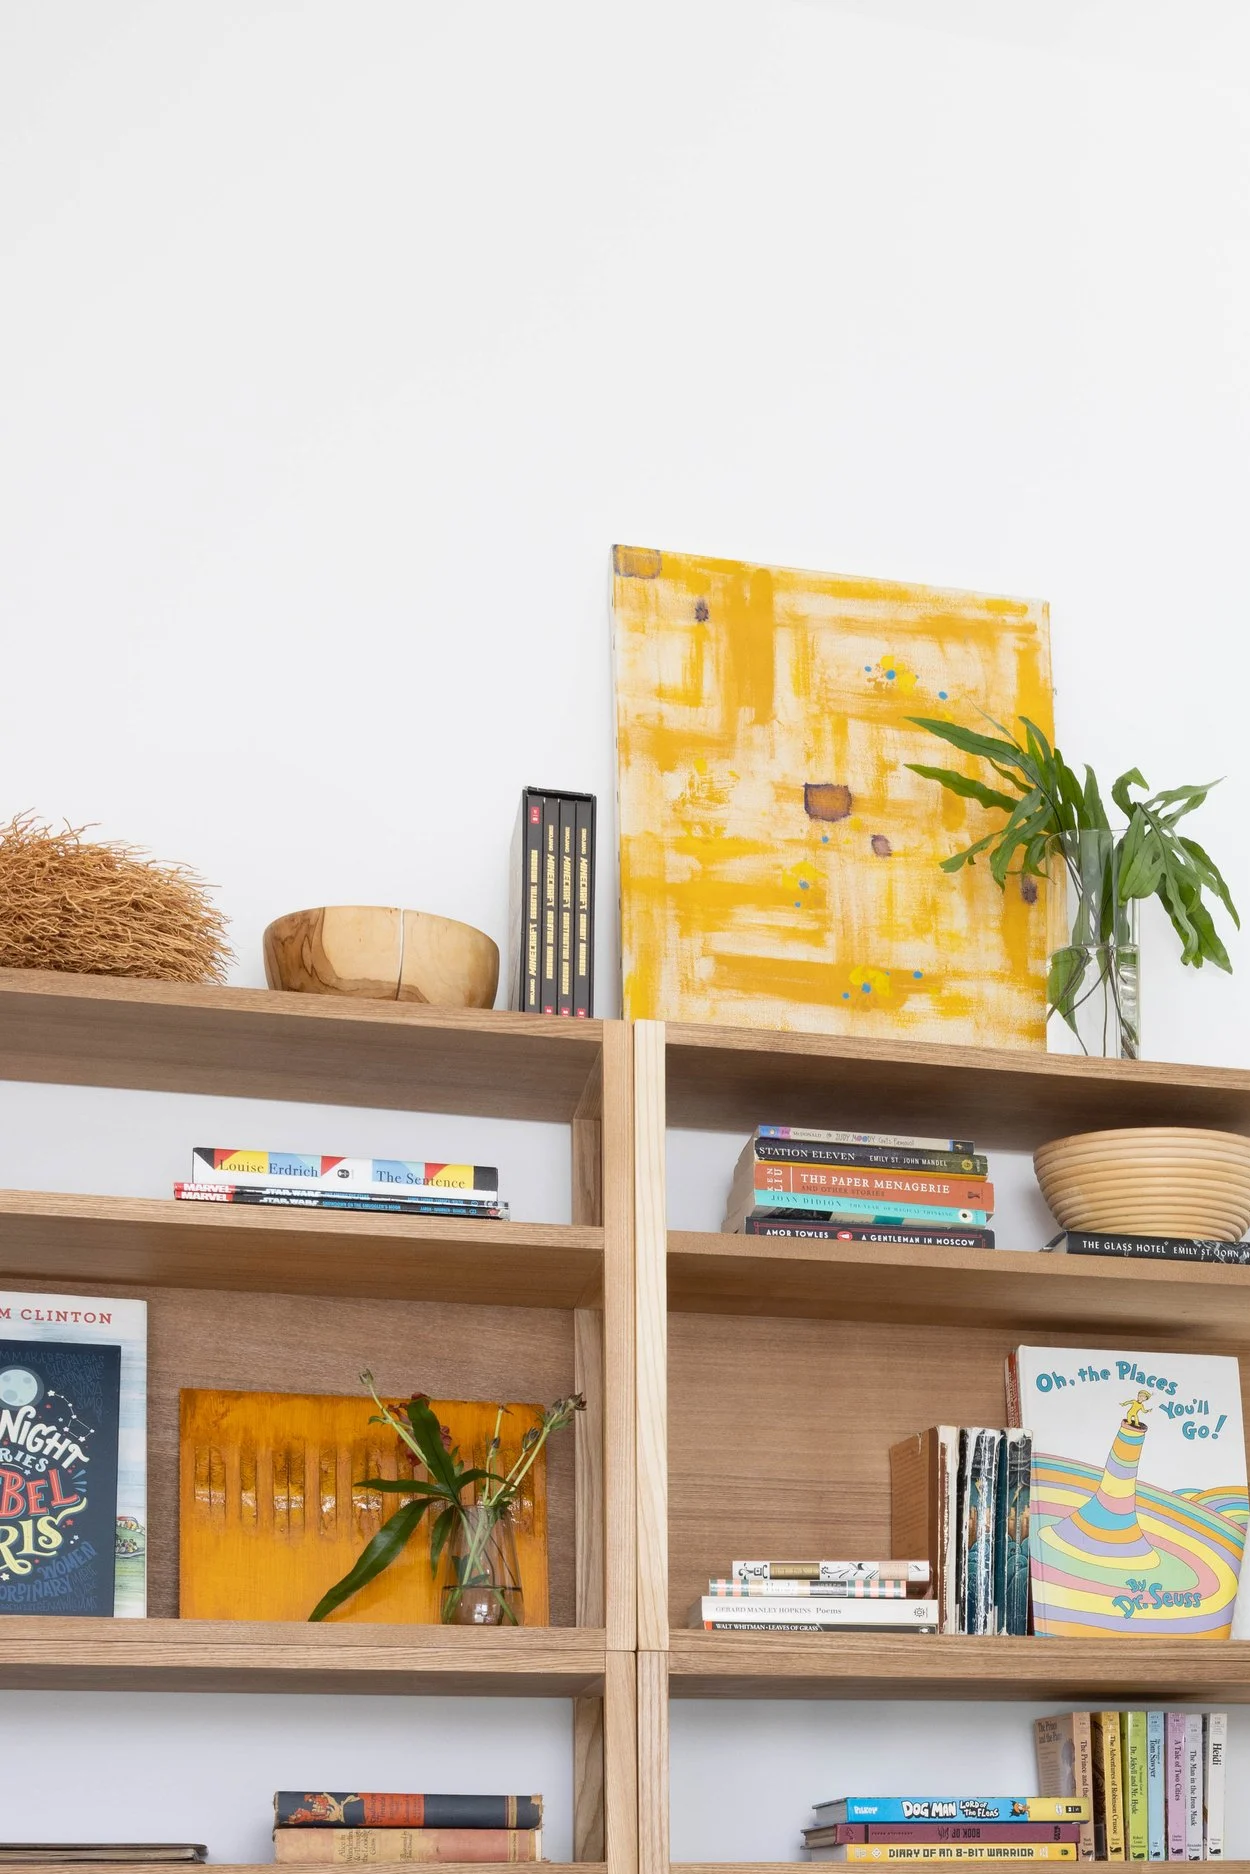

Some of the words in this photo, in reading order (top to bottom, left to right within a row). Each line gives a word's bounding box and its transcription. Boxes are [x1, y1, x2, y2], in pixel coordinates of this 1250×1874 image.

[547, 854, 555, 907] MINECRAFT
[563, 855, 571, 908] MINECRAFT
[760, 1147, 808, 1158] STATION
[812, 1150, 855, 1160] ELEVEN
[903, 1157, 920, 1165] JOHN
[921, 1159, 947, 1167] MANDEL
[219, 1159, 264, 1174] Louise
[269, 1163, 318, 1177] Erdrich
[377, 1170, 401, 1184] The
[406, 1173, 465, 1189] Sentence
[800, 1174, 827, 1184] THE
[831, 1176, 870, 1188] PAPER
[874, 1180, 950, 1194] MENAGERIE
[181, 1191, 229, 1201] MARVEL
[184, 1183, 232, 1193] MARVEL
[766, 1229, 791, 1237] AMOR
[795, 1230, 829, 1239] TOWLES
[870, 1234, 920, 1243] GENTLEMAN
[936, 1238, 975, 1246] MOSCOW
[1082, 1240, 1100, 1250] THE
[1103, 1241, 1133, 1252] GLASS
[1136, 1243, 1166, 1254] HOTEL
[1173, 1246, 1197, 1256] EMILY
[1201, 1248, 1213, 1257] ST.
[1214, 1249, 1239, 1258] JOHN
[21, 1309, 112, 1324] CLINTON
[1036, 1372, 1075, 1393] Oh,
[1078, 1365, 1111, 1383] the
[1115, 1360, 1178, 1395] Places
[1158, 1398, 1209, 1420] You'll
[1182, 1414, 1228, 1440] Go!
[1126, 1578, 1146, 1593] By
[1112, 1595, 1148, 1619] Dr.
[1149, 1582, 1202, 1609] Seuss
[1213, 1743, 1222, 1765] Heidi
[902, 1801, 929, 1818] DOG
[931, 1802, 956, 1817] MAN
[888, 1849, 920, 1858] DIARY
[923, 1849, 936, 1858] OF
[956, 1848, 984, 1857] 8-BIT
[987, 1848, 1034, 1857] WARRIOR
